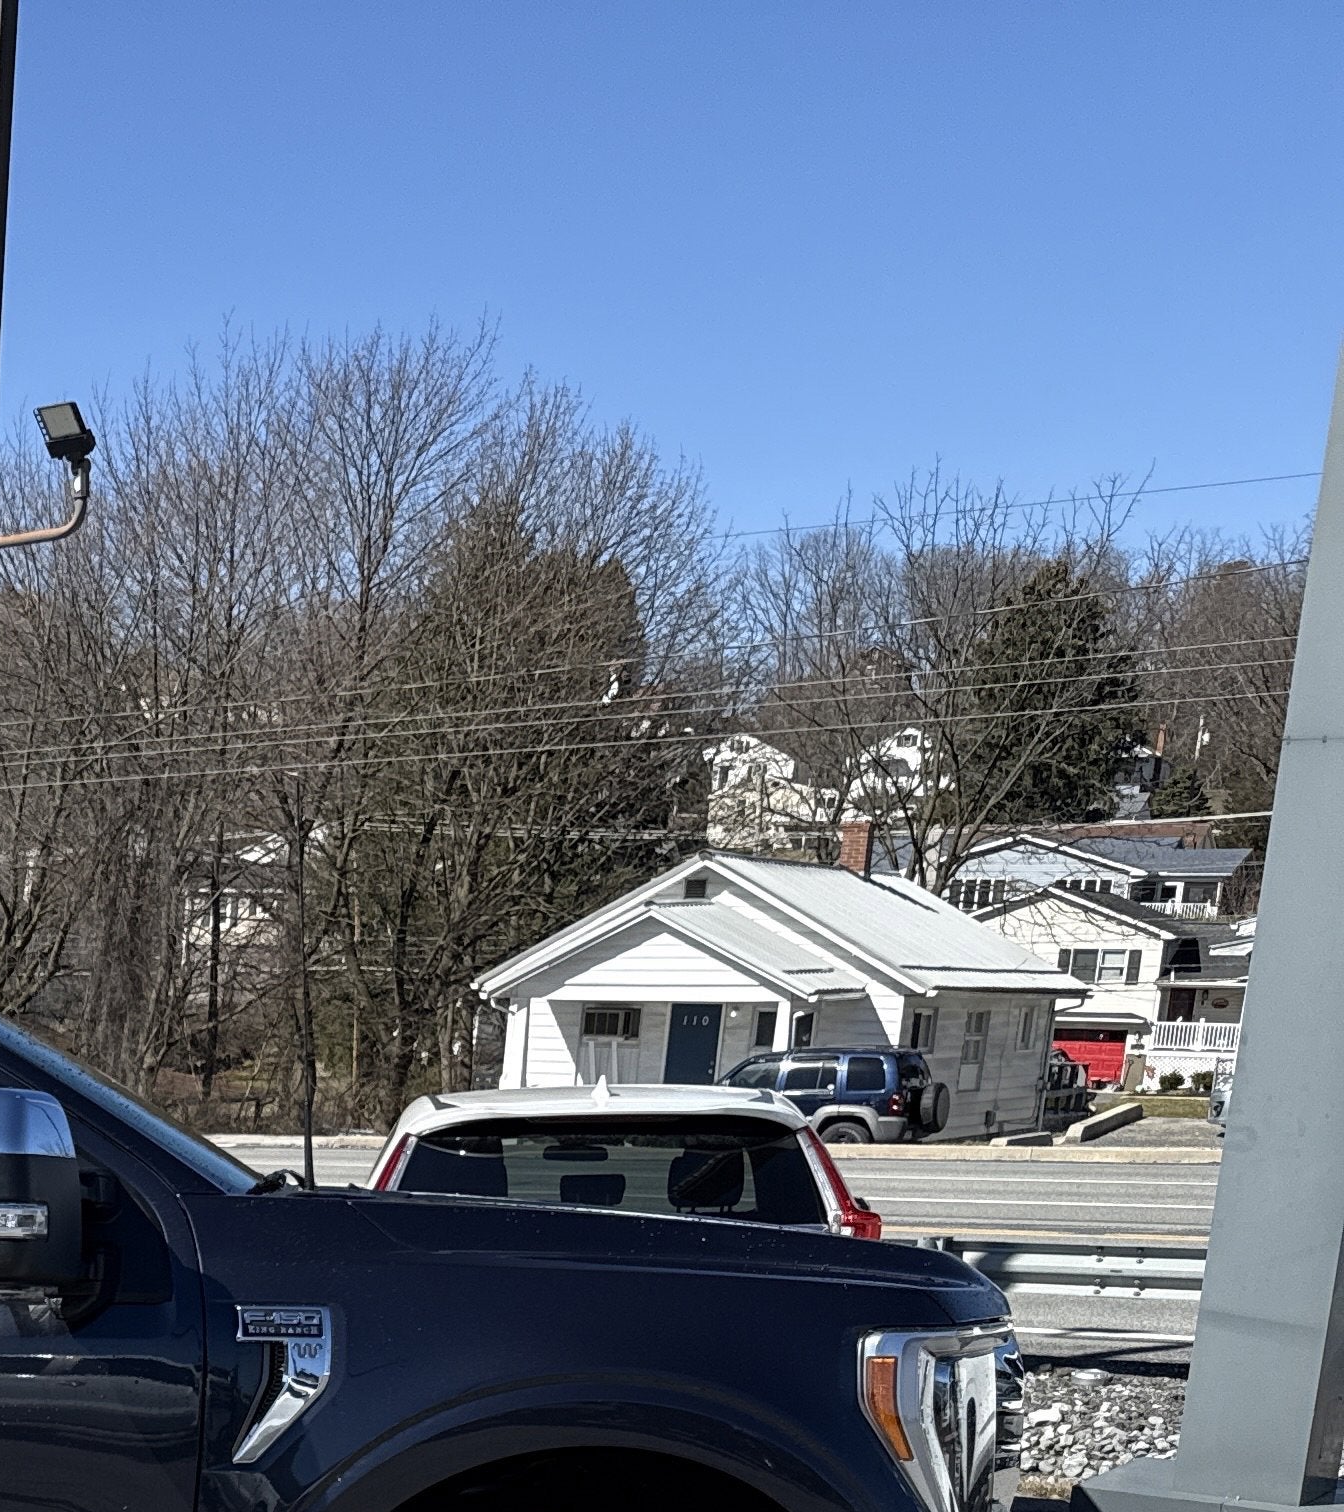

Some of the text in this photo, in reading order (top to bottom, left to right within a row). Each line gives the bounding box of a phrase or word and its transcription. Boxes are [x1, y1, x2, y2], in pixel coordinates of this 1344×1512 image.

[682, 1015, 710, 1026] 110
[243, 1311, 321, 1325] F-150
[248, 1325, 319, 1335] KING RANCH
